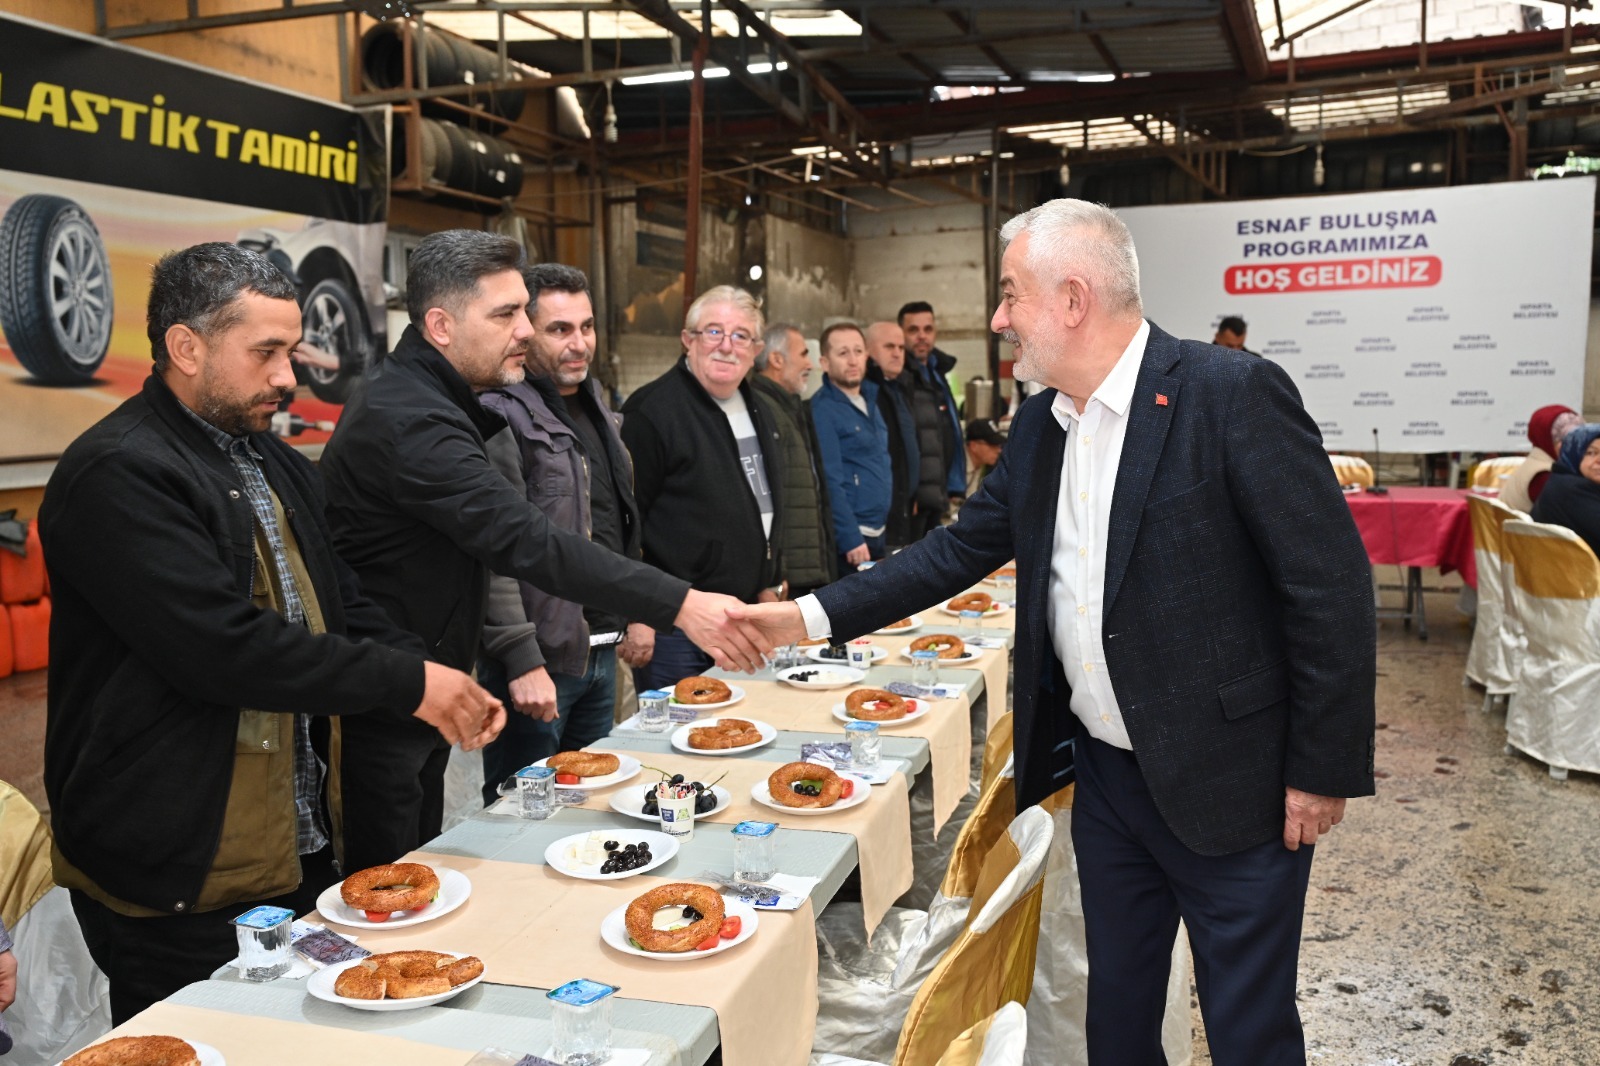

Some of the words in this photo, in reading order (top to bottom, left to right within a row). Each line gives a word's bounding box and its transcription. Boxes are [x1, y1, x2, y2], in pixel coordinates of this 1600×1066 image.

[206, 120, 357, 184] TAMİRİ
[1237, 217, 1311, 235] ESNAF
[1320, 209, 1437, 230] BULUŞMA
[1243, 234, 1428, 258] PROGRAMIMIZA
[1235, 268, 1291, 291] HOŞ
[1298, 258, 1430, 287] GELDİNİZ
